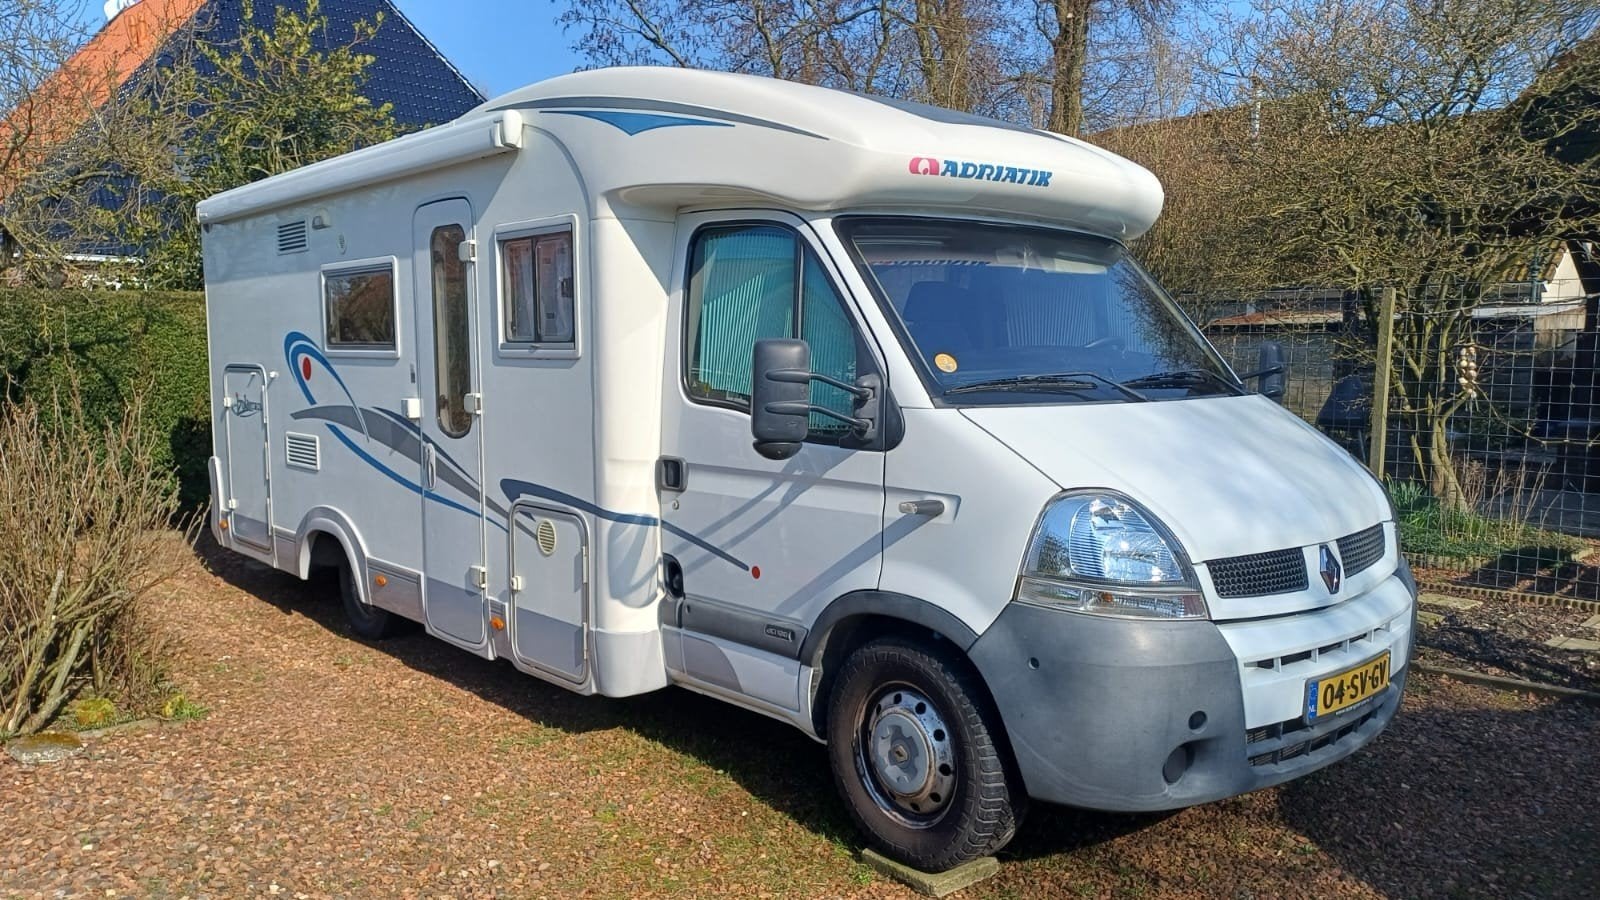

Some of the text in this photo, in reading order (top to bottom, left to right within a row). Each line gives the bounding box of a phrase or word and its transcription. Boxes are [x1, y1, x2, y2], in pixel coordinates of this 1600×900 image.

[940, 159, 1053, 187] ADRIATIK
[1322, 659, 1387, 710] 04-SV-GV
[1308, 704, 1317, 713] NL
